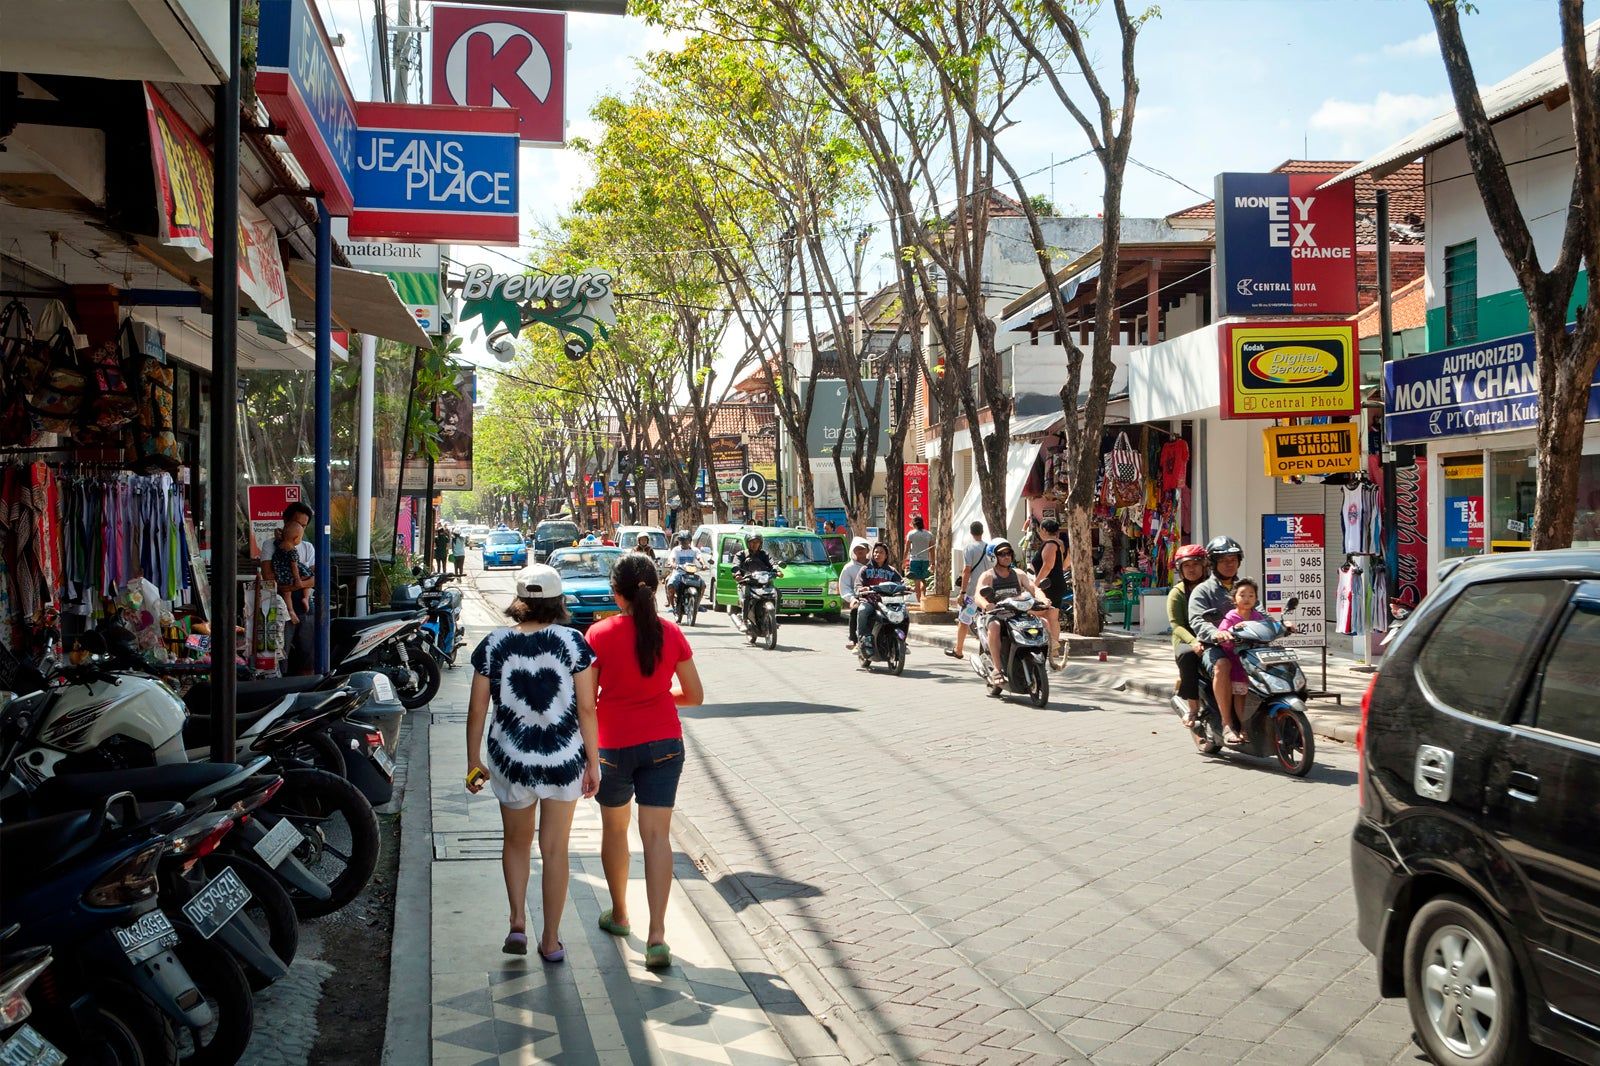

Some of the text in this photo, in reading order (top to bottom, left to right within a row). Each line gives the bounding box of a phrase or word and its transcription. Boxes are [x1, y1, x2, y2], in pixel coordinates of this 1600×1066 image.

[297, 15, 327, 123] JEANS
[466, 31, 545, 107] K
[357, 137, 464, 175] JEANS
[406, 168, 510, 205] PLACE
[341, 243, 423, 258] mataBank
[461, 263, 612, 301] Brewers
[1253, 283, 1317, 292] CENTRAL KUTA
[1243, 344, 1264, 352] Kodak
[1273, 352, 1320, 365] Digital
[1442, 342, 1524, 375] AUTHORIZED
[1269, 364, 1324, 375] Services
[1394, 362, 1538, 412] MONEY CHAN
[1261, 395, 1344, 409] Central Photo
[1446, 411, 1464, 430] PT.
[1464, 407, 1508, 427] Central
[1278, 432, 1339, 446] WESTERN
[1298, 443, 1339, 455] UNION
[1278, 458, 1352, 470] OPEN DAILY
[1300, 557, 1321, 567] 9485
[1300, 573, 1321, 583] 9865
[1297, 590, 1321, 599] 11640
[1301, 607, 1321, 616] 7565
[1297, 623, 1321, 632] 121.10
